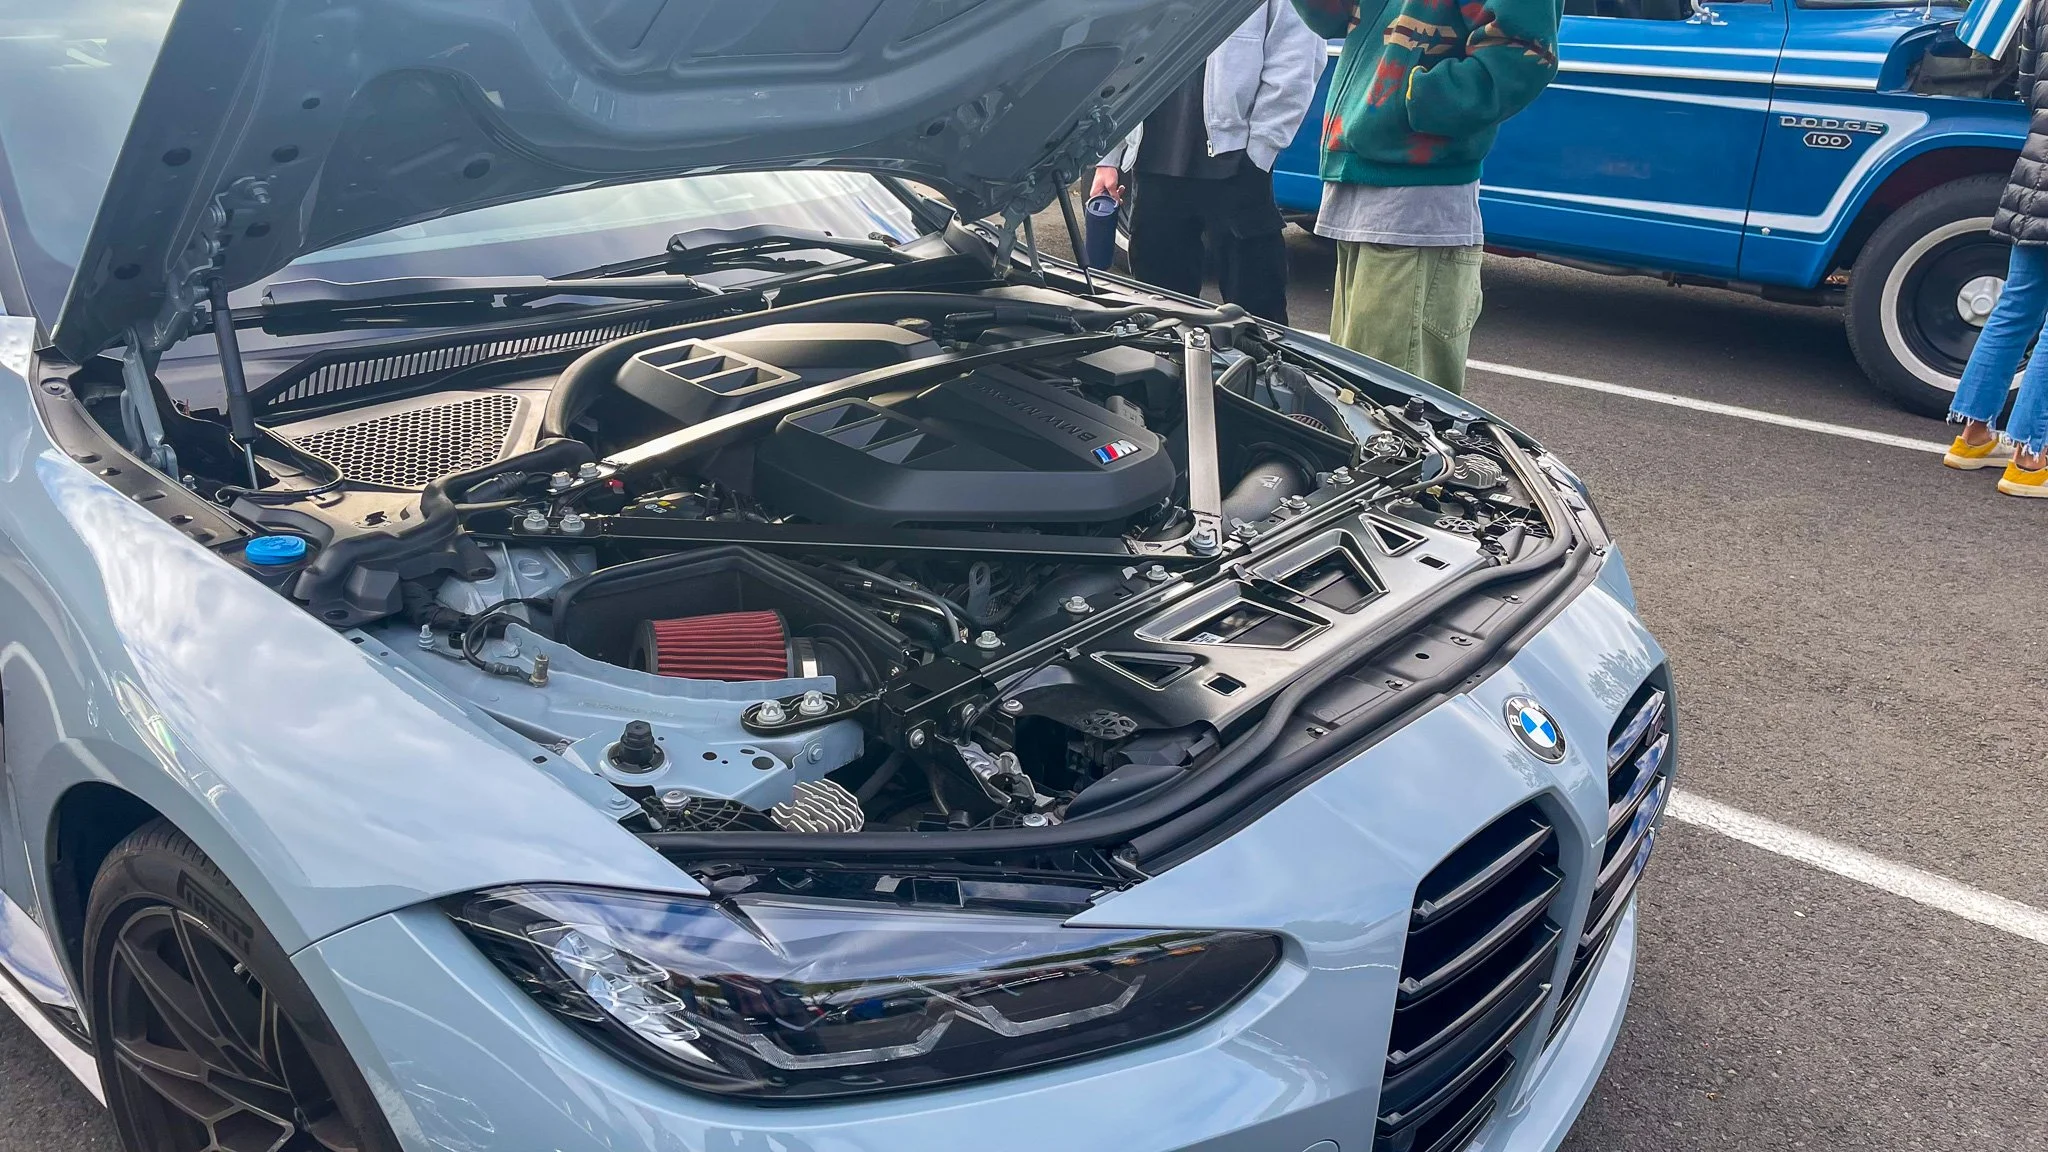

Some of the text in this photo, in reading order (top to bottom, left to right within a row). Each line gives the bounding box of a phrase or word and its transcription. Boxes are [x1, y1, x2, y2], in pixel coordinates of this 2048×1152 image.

[1780, 115, 1884, 134] DODGE
[1812, 134, 1842, 145] 100
[177, 869, 254, 956] PIRELLI
